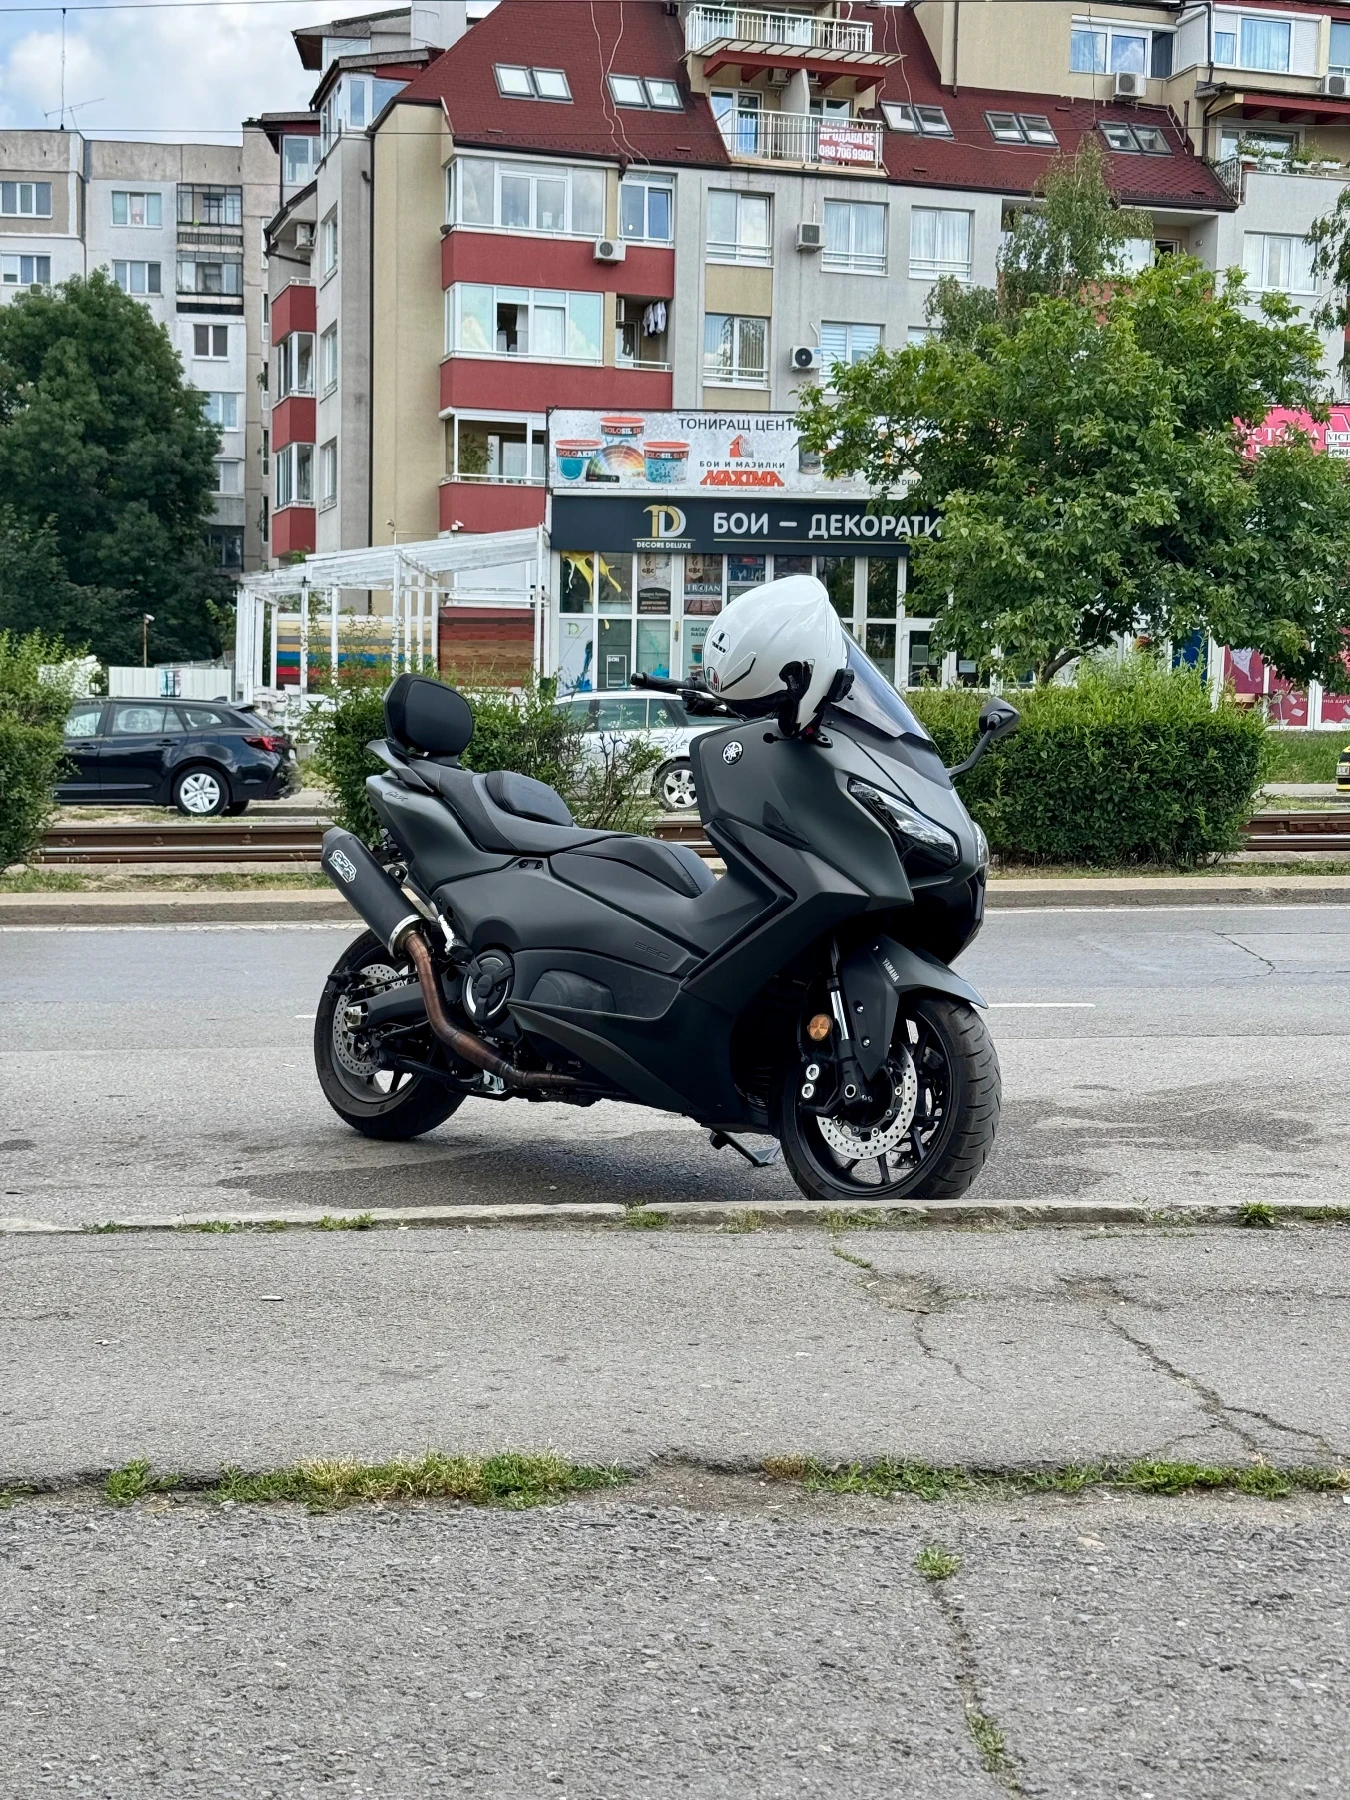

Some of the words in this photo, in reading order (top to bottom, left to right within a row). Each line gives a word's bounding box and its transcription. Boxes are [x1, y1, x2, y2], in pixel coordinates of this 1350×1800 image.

[820, 127, 863, 145] ПРОДАВА
[863, 132, 874, 146] СЕ
[819, 145, 836, 157] 088
[837, 147, 852, 159] 706
[678, 418, 751, 432] ТОНИРАЩ
[755, 420, 805, 433] ЦЕНТ
[735, 461, 785, 469] МАЗИЛКИ
[700, 470, 785, 487] MAXIMA
[713, 512, 769, 535] БОИ
[882, 957, 900, 983] YAMAHA
